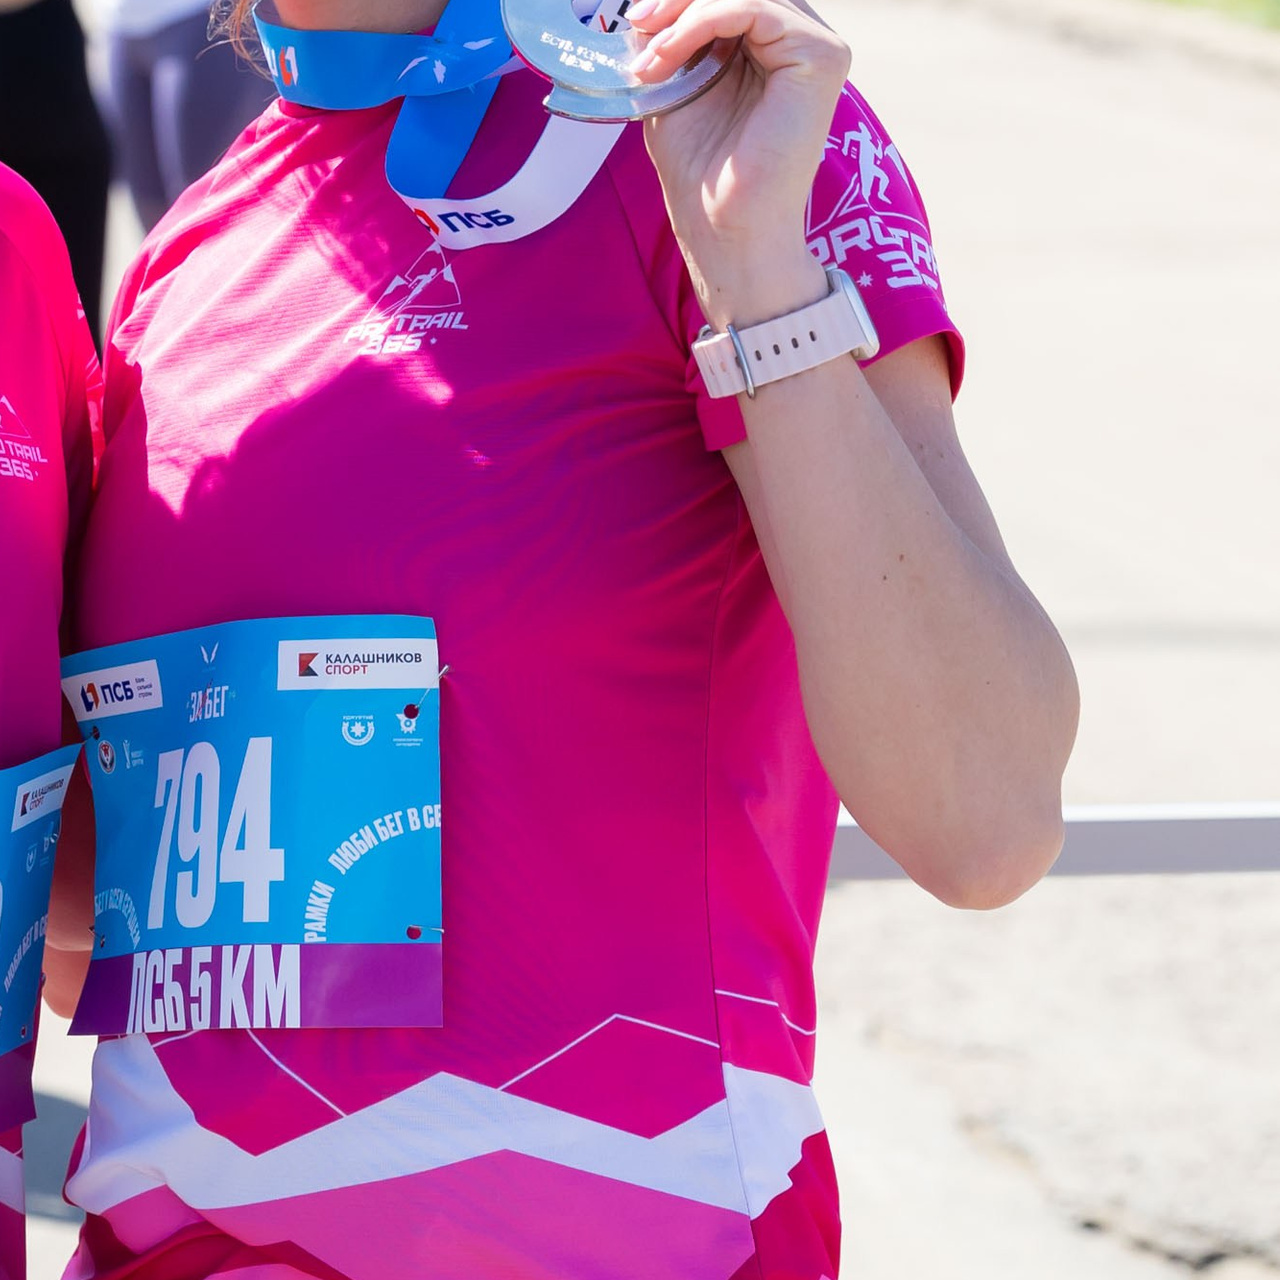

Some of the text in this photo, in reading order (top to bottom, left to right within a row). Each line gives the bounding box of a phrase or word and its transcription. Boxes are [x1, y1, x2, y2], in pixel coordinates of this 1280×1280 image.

[437, 209, 515, 233] ПСБ
[394, 311, 469, 332] TRAIL
[4, 439, 49, 463] TRAIL
[325, 652, 423, 664] КАЛАШНИКОВ
[325, 664, 368, 675] СПОРТ
[100, 680, 134, 705] ПСБ
[146, 736, 285, 930] 794
[327, 825, 379, 875] ЛЮБИ
[372, 811, 404, 842] БЕГ
[406, 807, 421, 832] В
[304, 880, 336, 943] РАМКИ
[126, 944, 301, 1034] ПСБ 5 КМ
